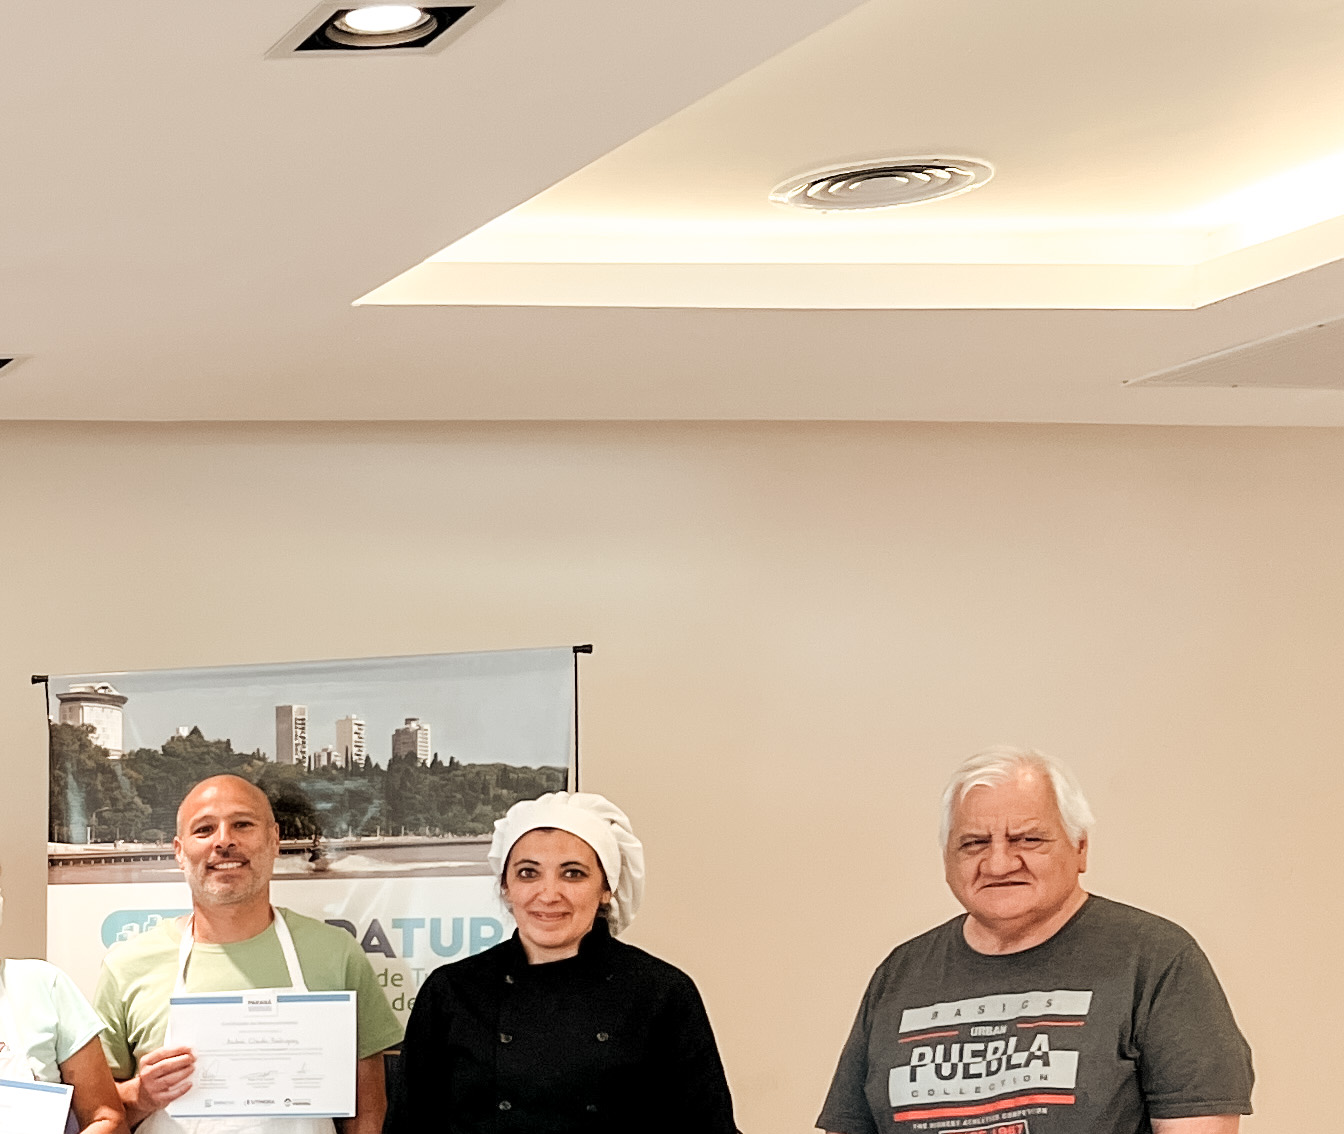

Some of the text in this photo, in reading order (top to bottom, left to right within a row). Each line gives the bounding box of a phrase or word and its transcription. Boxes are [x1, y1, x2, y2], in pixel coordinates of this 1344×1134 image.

[930, 999, 1053, 1021] BASICS
[970, 1025, 1007, 1037] URBAN
[909, 1033, 1051, 1083] PUEBLA
[911, 1074, 1049, 1098] COLLECTION
